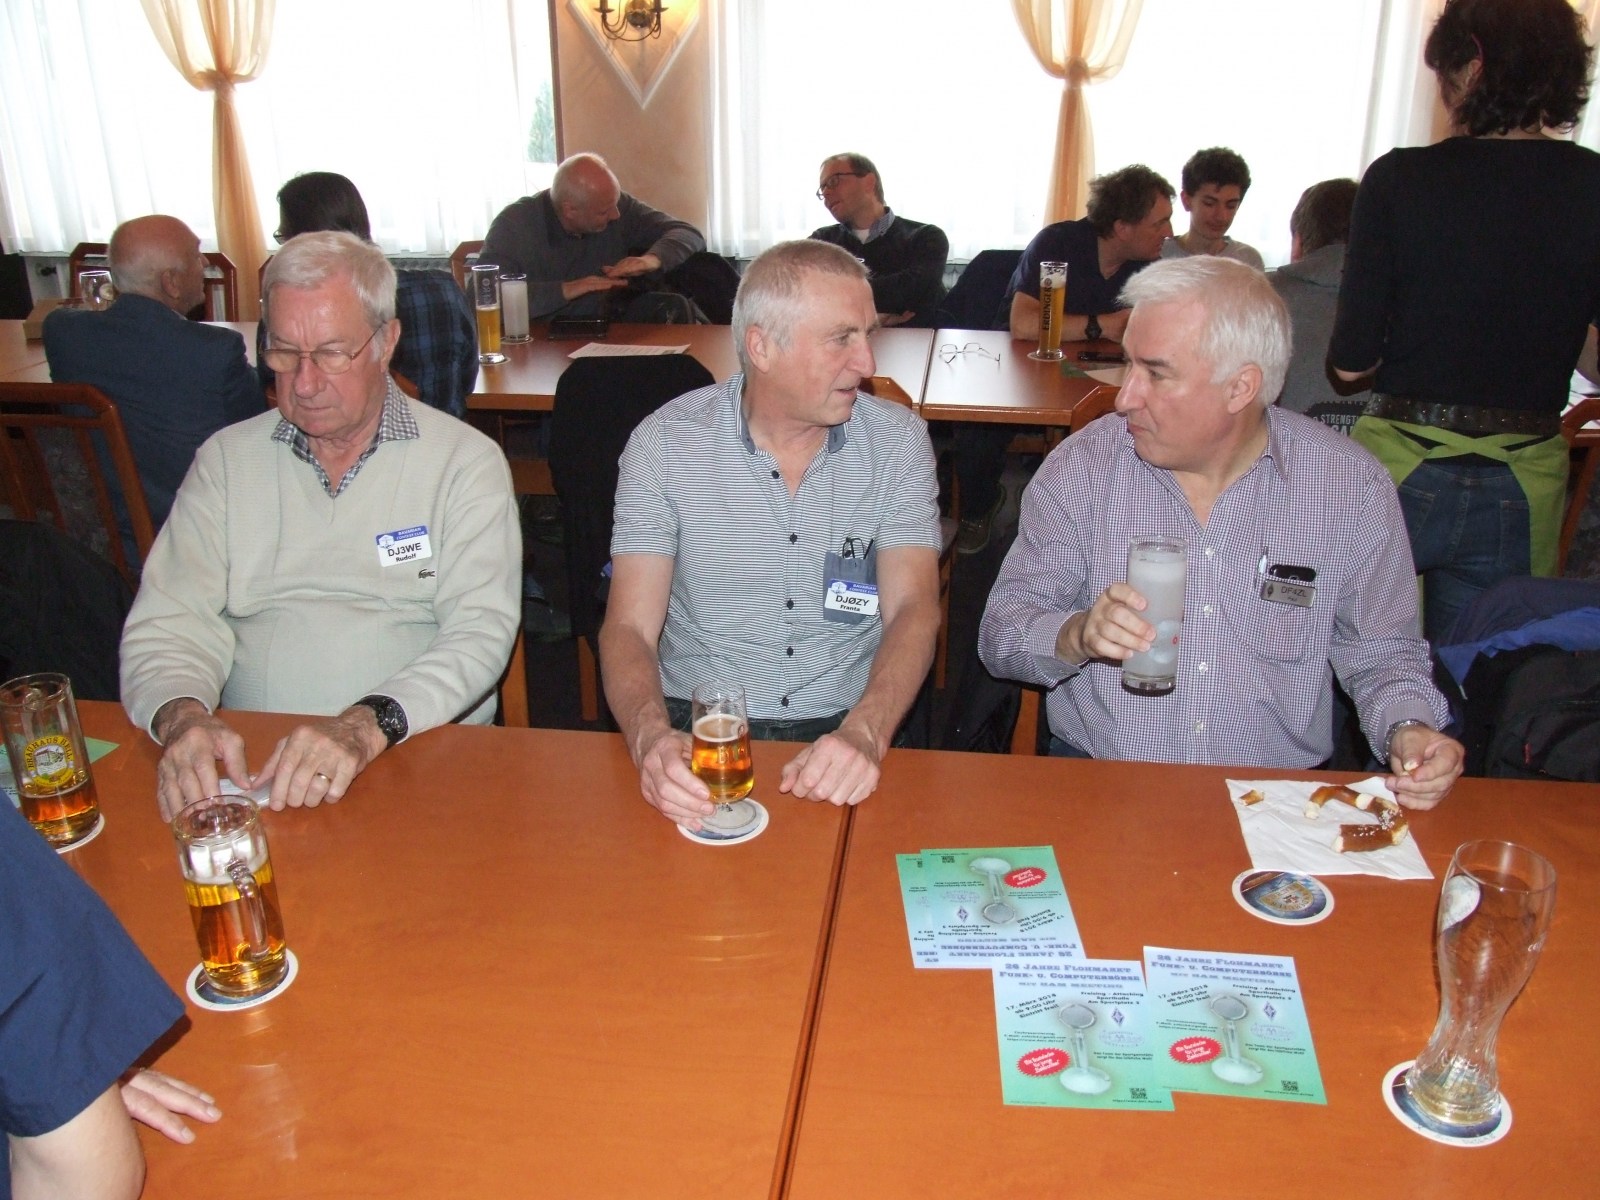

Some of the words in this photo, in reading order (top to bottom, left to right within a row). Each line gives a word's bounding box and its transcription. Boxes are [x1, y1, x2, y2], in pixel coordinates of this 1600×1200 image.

[1042, 286, 1053, 330] ERDINGER
[1320, 413, 1360, 424] STRENGT
[387, 543, 422, 557] DJ3WE
[395, 553, 417, 562] Rudolf
[840, 604, 861, 612] Franta
